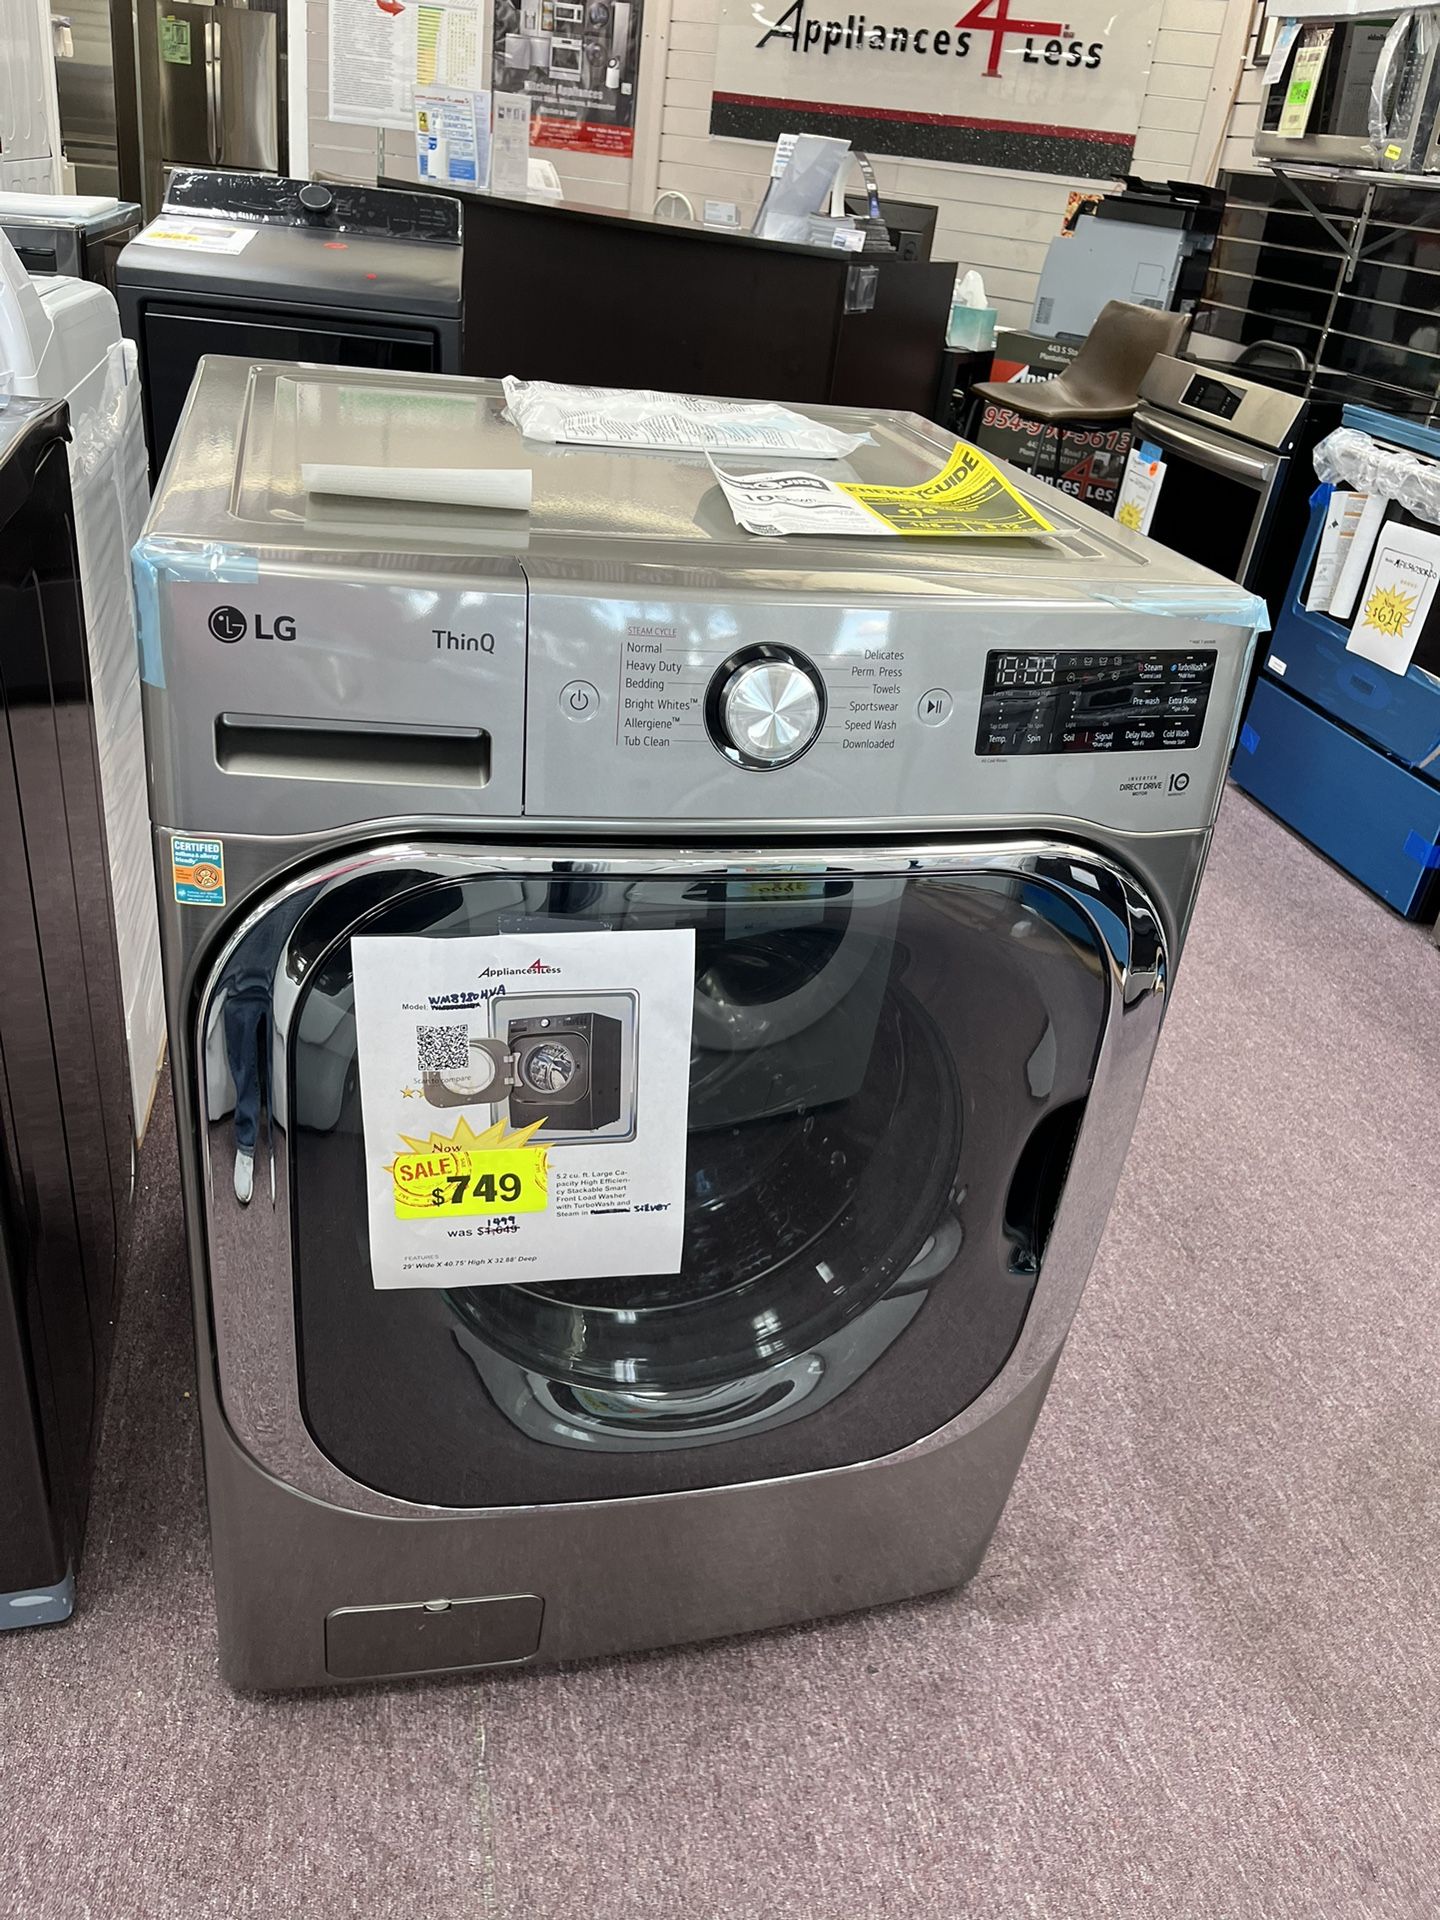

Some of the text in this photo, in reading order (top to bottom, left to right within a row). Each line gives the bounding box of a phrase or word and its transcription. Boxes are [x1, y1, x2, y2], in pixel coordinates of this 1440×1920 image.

[755, 0, 1104, 78] Appliances 4 Less
[1086, 485, 1117, 503] Les
[254, 614, 495, 655] LG ThinQ
[628, 626, 677, 637] STEAM CYCLE
[626, 642, 662, 654] Normal
[864, 649, 905, 660] Delicates
[626, 660, 682, 675] Heavy Duty
[879, 666, 903, 677] Press
[1144, 662, 1164, 672] Steam
[625, 677, 665, 691] Bedding
[872, 683, 901, 694] Towels
[624, 698, 654, 712] Bright
[1168, 695, 1182, 705] Extra
[1182, 695, 1198, 705] Rinse
[849, 700, 899, 713] Sportswear
[844, 720, 897, 732] Speed Wash
[1027, 733, 1041, 744] Spin
[1062, 733, 1076, 742] Soil
[1094, 731, 1114, 742] Signal
[1125, 730, 1155, 741] Delay Wash
[1162, 730, 1190, 738] Cold Wash
[624, 736, 670, 747] Tub Clean
[842, 739, 895, 749] Downloaded
[1119, 781, 1163, 792] DIRECT DRIVE
[1168, 772, 1190, 792] 10
[174, 840, 220, 853] CERTIFIED
[431, 1143, 462, 1154] Now
[399, 1157, 451, 1182] SALE
[592, 1171, 613, 1179] Large
[556, 1180, 579, 1188] pacity
[580, 1179, 598, 1187] High
[431, 1172, 522, 1207] $749
[567, 1186, 603, 1195] Stackable
[598, 1192, 626, 1200] Washer
[574, 1201, 615, 1209] TurboWash
[447, 1228, 473, 1238] was
[467, 1259, 486, 1267] High
